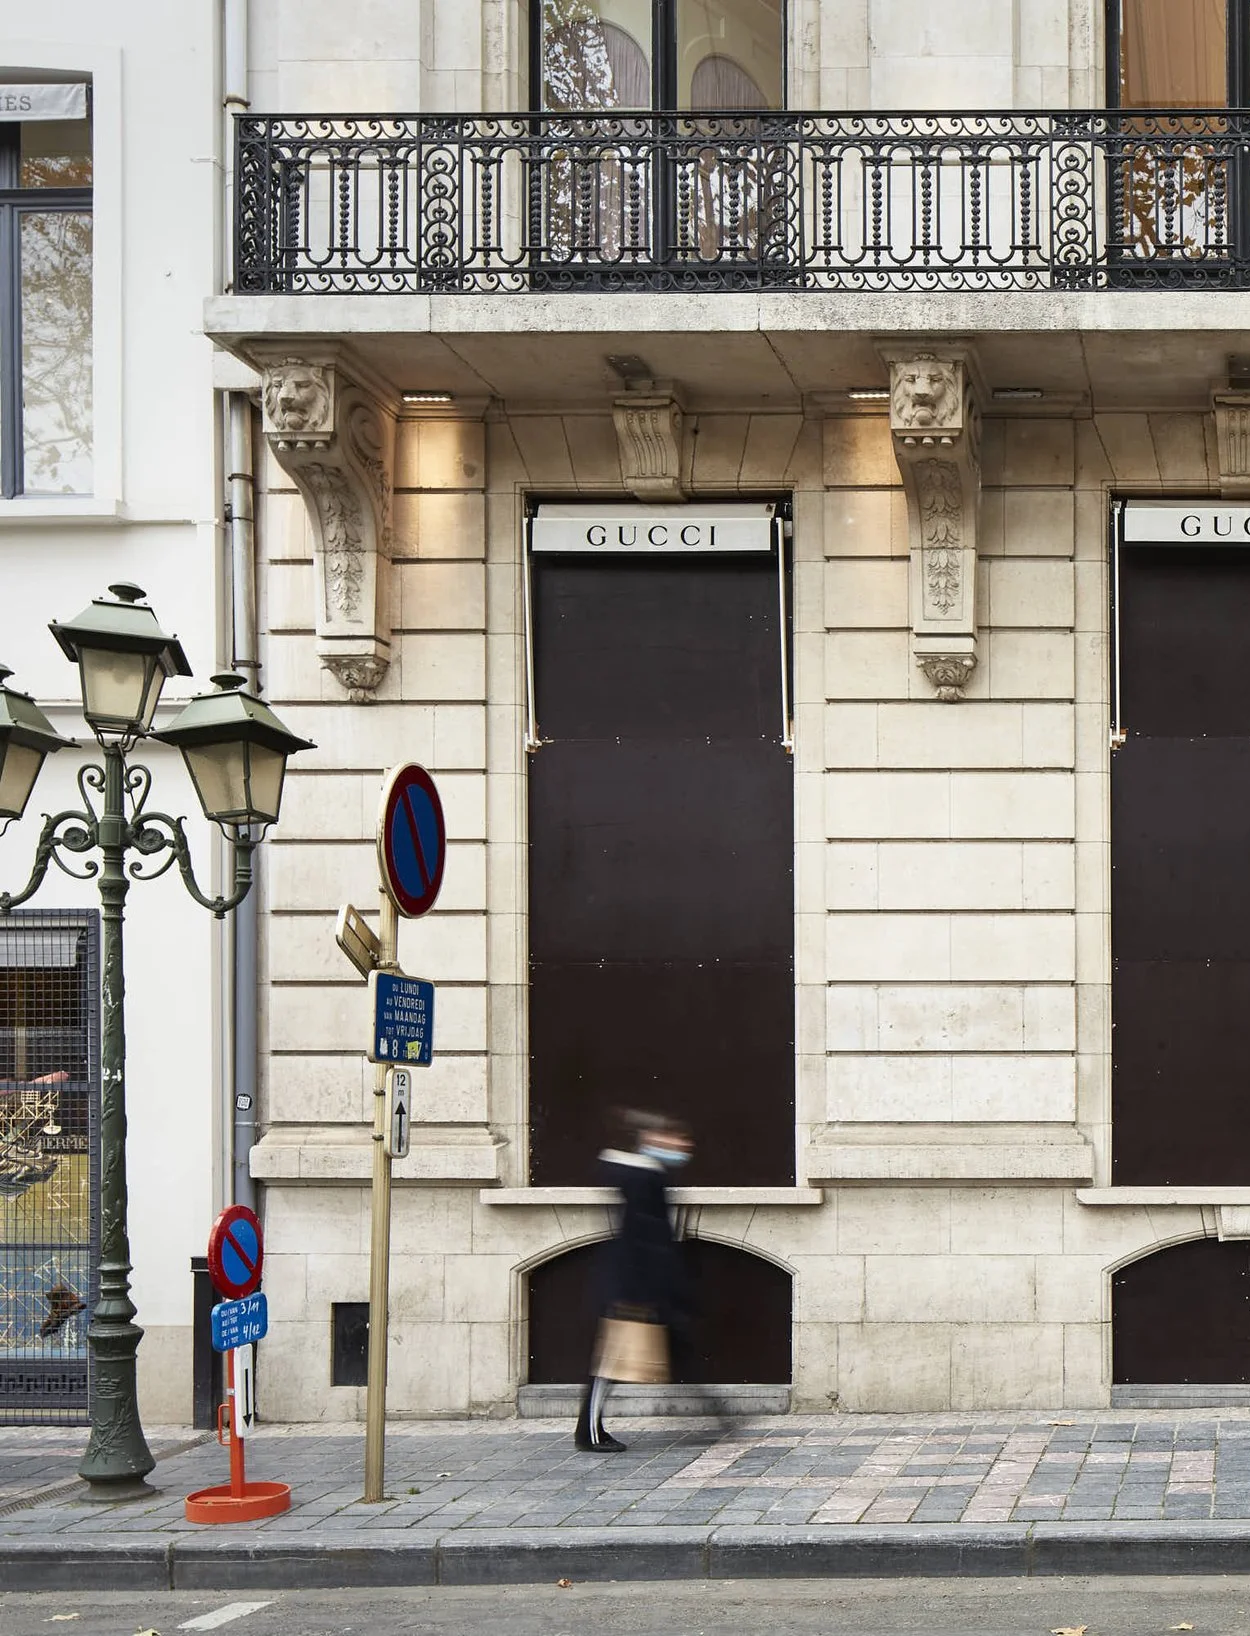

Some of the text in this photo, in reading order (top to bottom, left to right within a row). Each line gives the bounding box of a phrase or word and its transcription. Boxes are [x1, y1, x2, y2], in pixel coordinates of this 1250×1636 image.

[586, 525, 718, 546] GUCCI
[400, 981, 419, 995] LUNDI
[394, 995, 425, 1011] VENDREDI
[394, 1009, 426, 1025] MAANDAG
[396, 1024, 424, 1039] VRIJDAG
[392, 1039, 398, 1058] 8
[396, 1074, 406, 1086] 12
[398, 1089, 405, 1097] m
